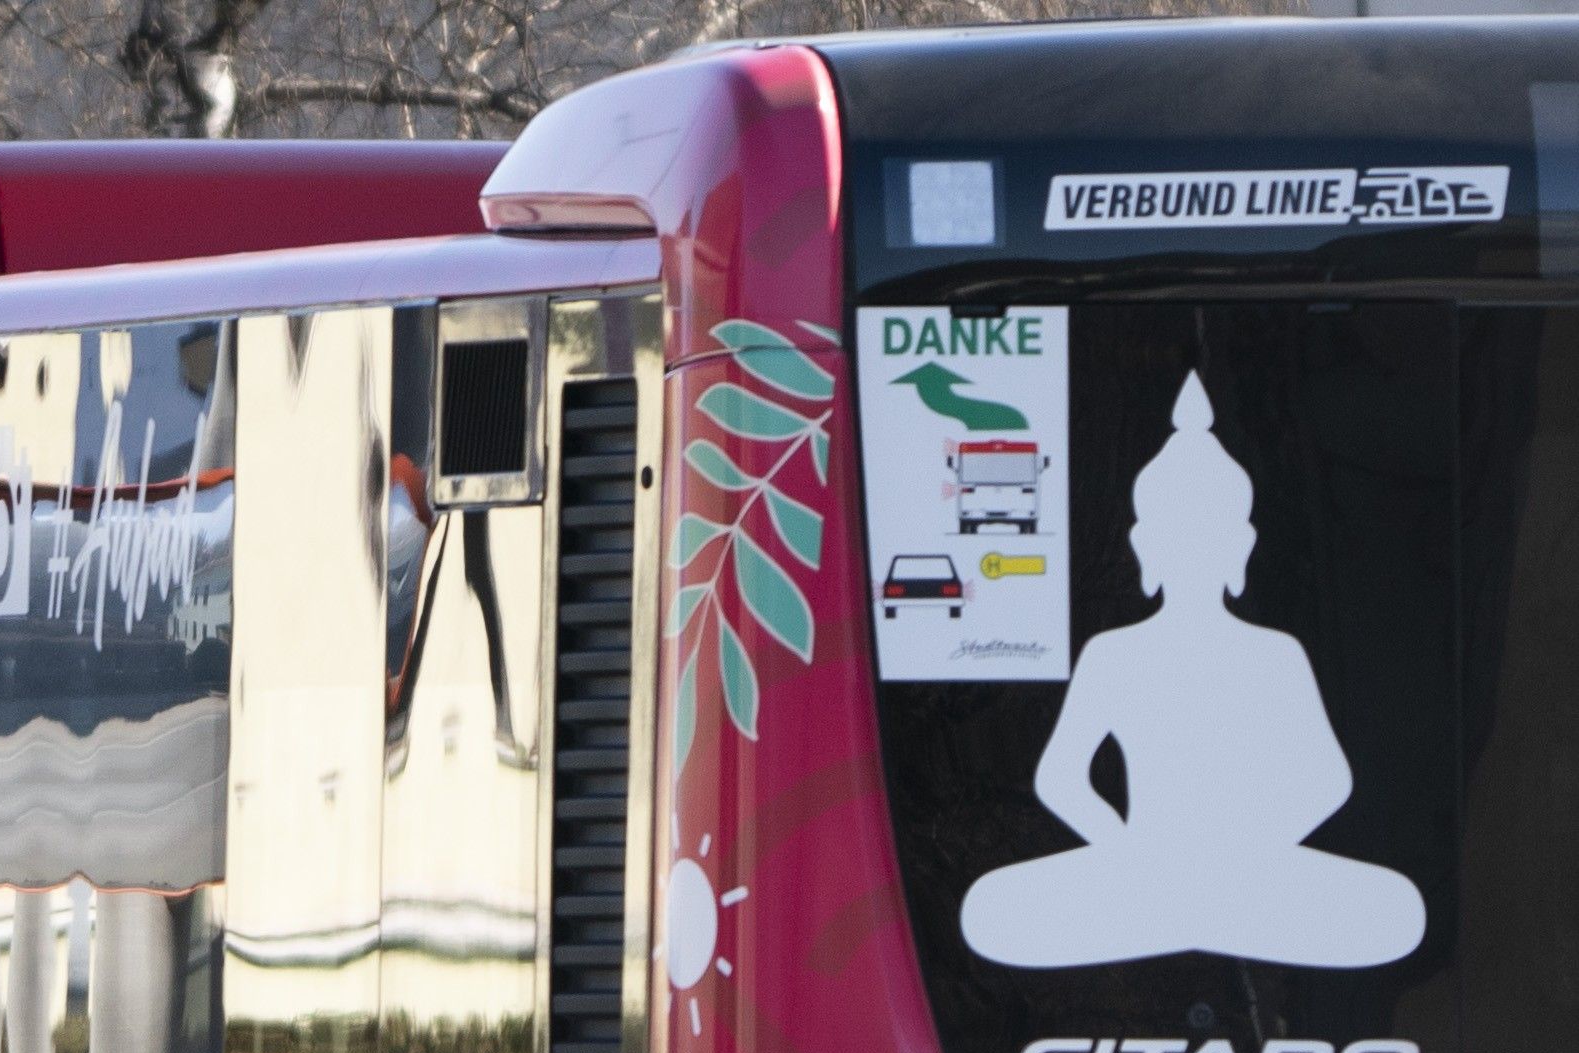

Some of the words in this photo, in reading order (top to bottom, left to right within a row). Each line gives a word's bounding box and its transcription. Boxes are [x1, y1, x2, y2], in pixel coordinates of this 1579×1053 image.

[1063, 181, 1236, 219] VERBUND
[1246, 178, 1342, 217] LINIE
[883, 317, 1043, 355] DANKE
